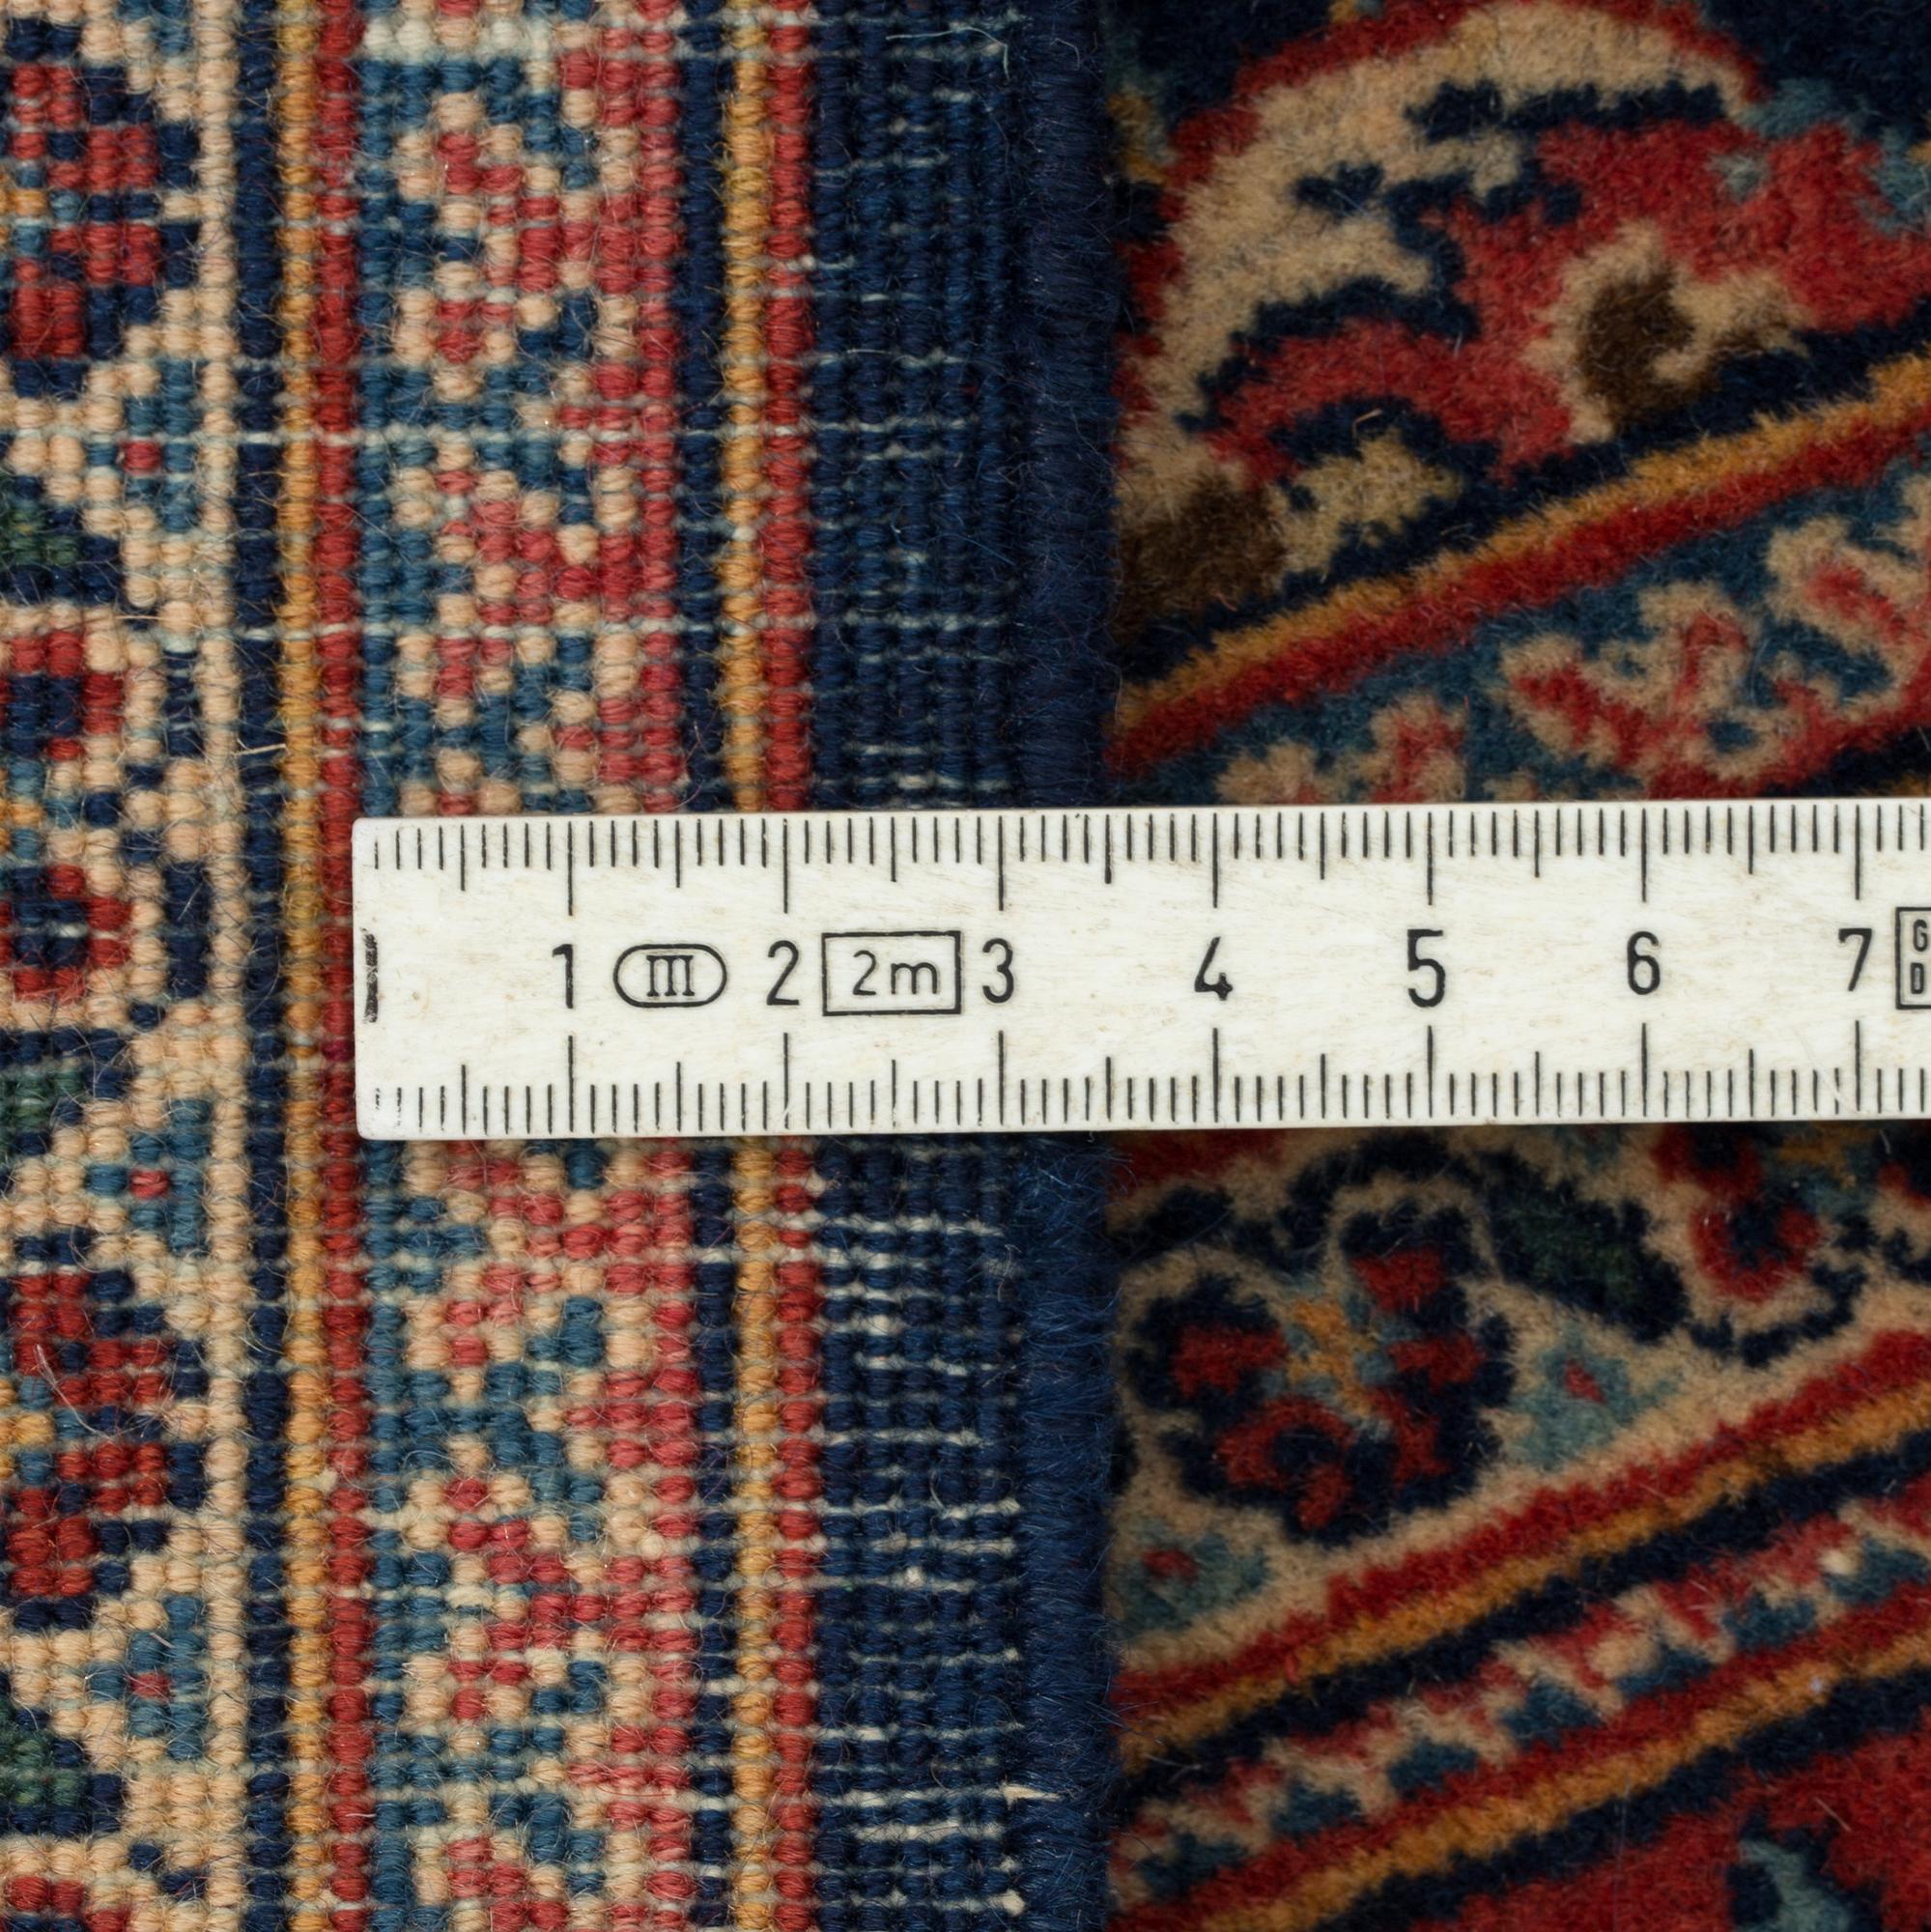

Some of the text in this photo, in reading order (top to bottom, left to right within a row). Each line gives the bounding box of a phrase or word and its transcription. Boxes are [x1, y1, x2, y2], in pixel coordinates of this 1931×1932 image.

[552, 943, 574, 1009] 1
[766, 940, 800, 1007] 2
[981, 937, 1014, 1004] 3
[1194, 936, 1234, 1002] 4
[1406, 928, 1447, 1009] 5
[1627, 930, 1662, 996] 6
[1837, 927, 1873, 992] 7
